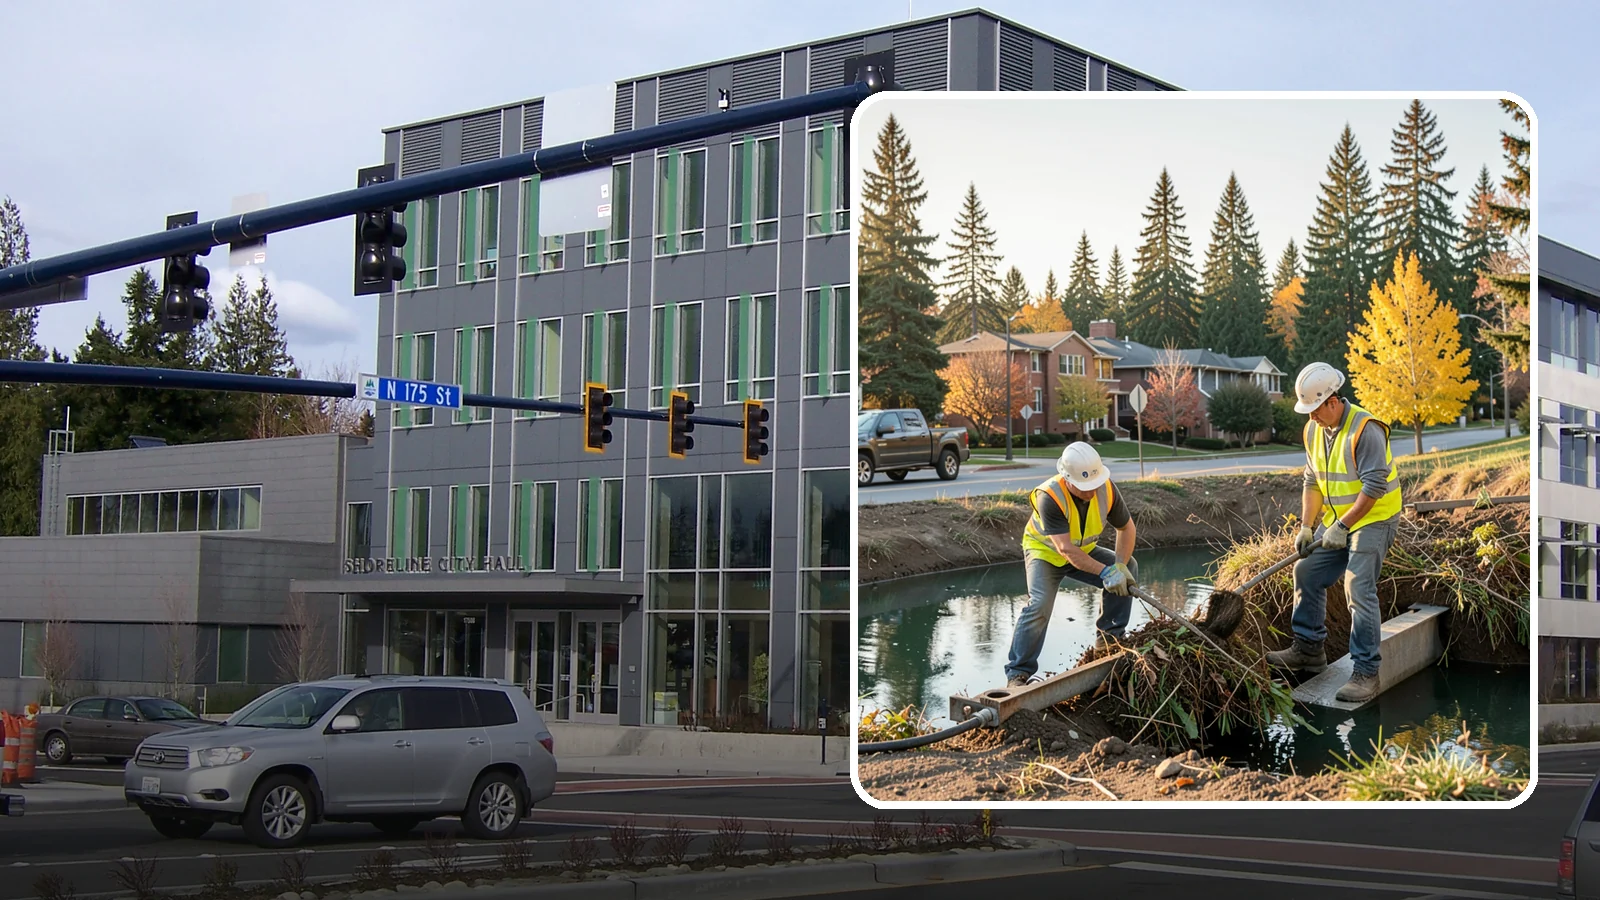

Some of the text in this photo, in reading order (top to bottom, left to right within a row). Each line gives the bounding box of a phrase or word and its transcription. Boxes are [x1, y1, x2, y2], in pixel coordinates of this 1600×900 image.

[387, 380, 452, 406] N 175 St
[344, 555, 526, 574] SHORELINE CITY HALL
